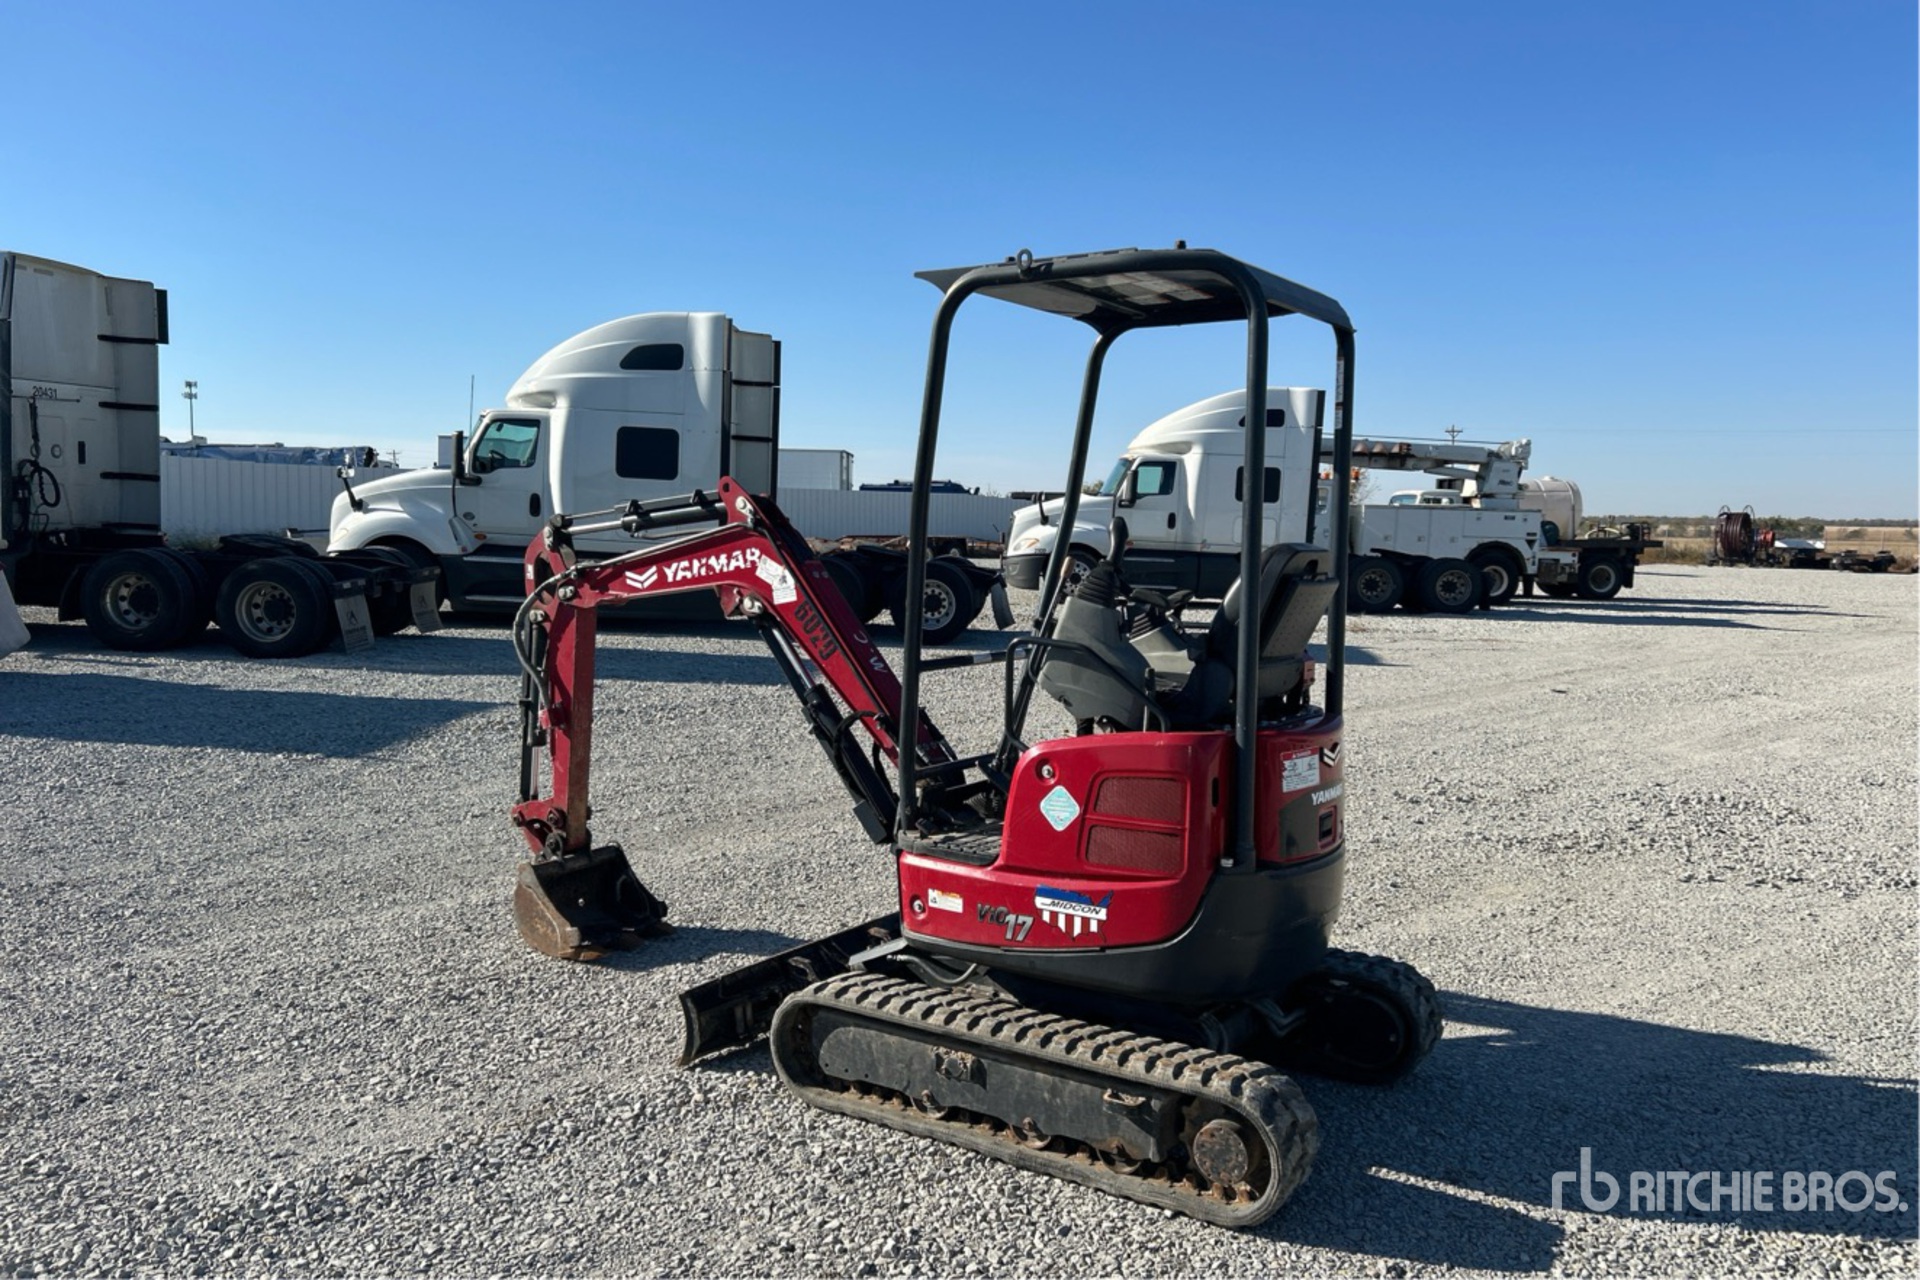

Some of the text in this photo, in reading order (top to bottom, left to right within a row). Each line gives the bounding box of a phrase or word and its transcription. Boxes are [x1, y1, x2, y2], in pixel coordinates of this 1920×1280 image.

[662, 547, 761, 583] YANMAR
[1311, 783, 1343, 806] YANMA
[1050, 899, 1102, 916] MIDCON
